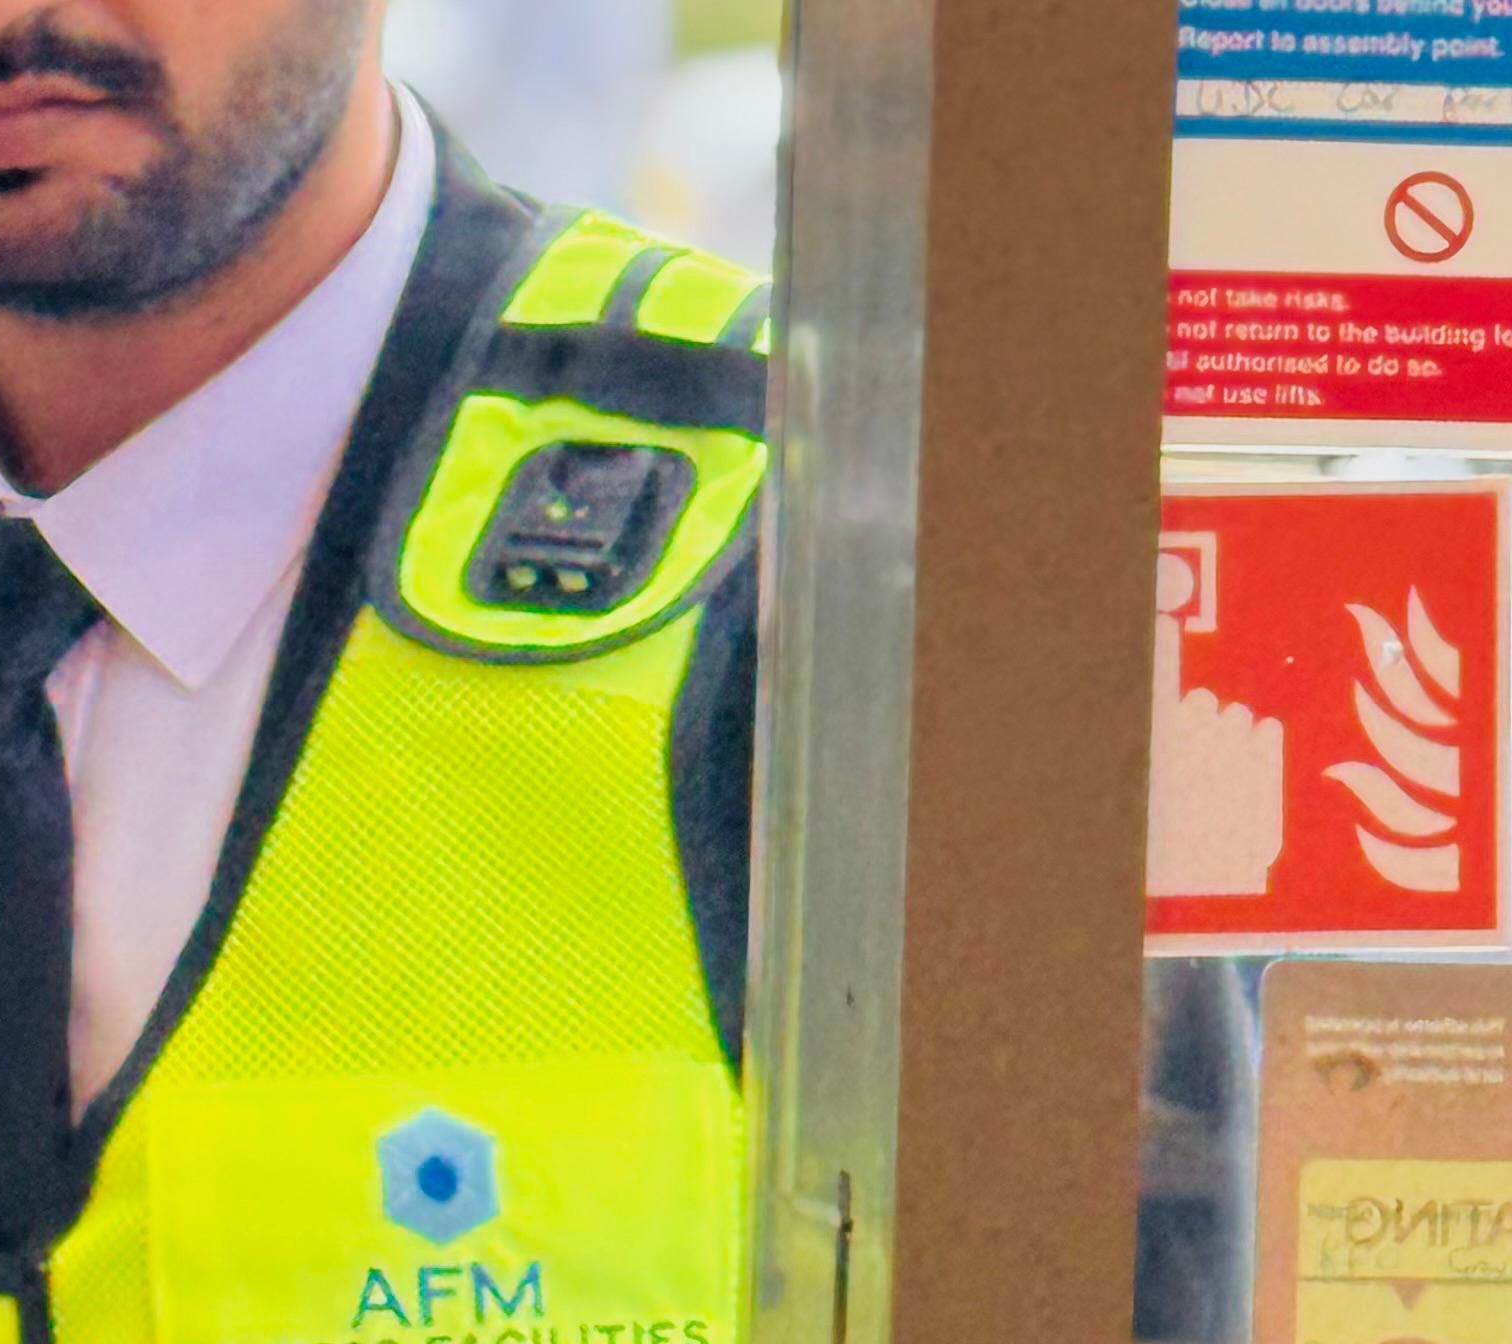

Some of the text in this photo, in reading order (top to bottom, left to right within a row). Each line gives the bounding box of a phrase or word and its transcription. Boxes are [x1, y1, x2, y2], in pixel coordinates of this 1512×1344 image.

[1178, 26, 1263, 55] Report
[1271, 28, 1295, 52] to
[1303, 31, 1424, 61] assembly
[1178, 288, 1217, 308] not
[1225, 289, 1278, 309] take
[1177, 320, 1216, 340] not
[1224, 322, 1298, 342] return
[1307, 322, 1331, 343] to
[1339, 323, 1378, 344] the
[1384, 324, 1486, 353] building
[1196, 352, 1328, 374] authorised
[1336, 354, 1361, 376] to
[1367, 354, 1399, 376] do
[1223, 387, 1267, 404] use
[350, 1260, 546, 1328] AFM
